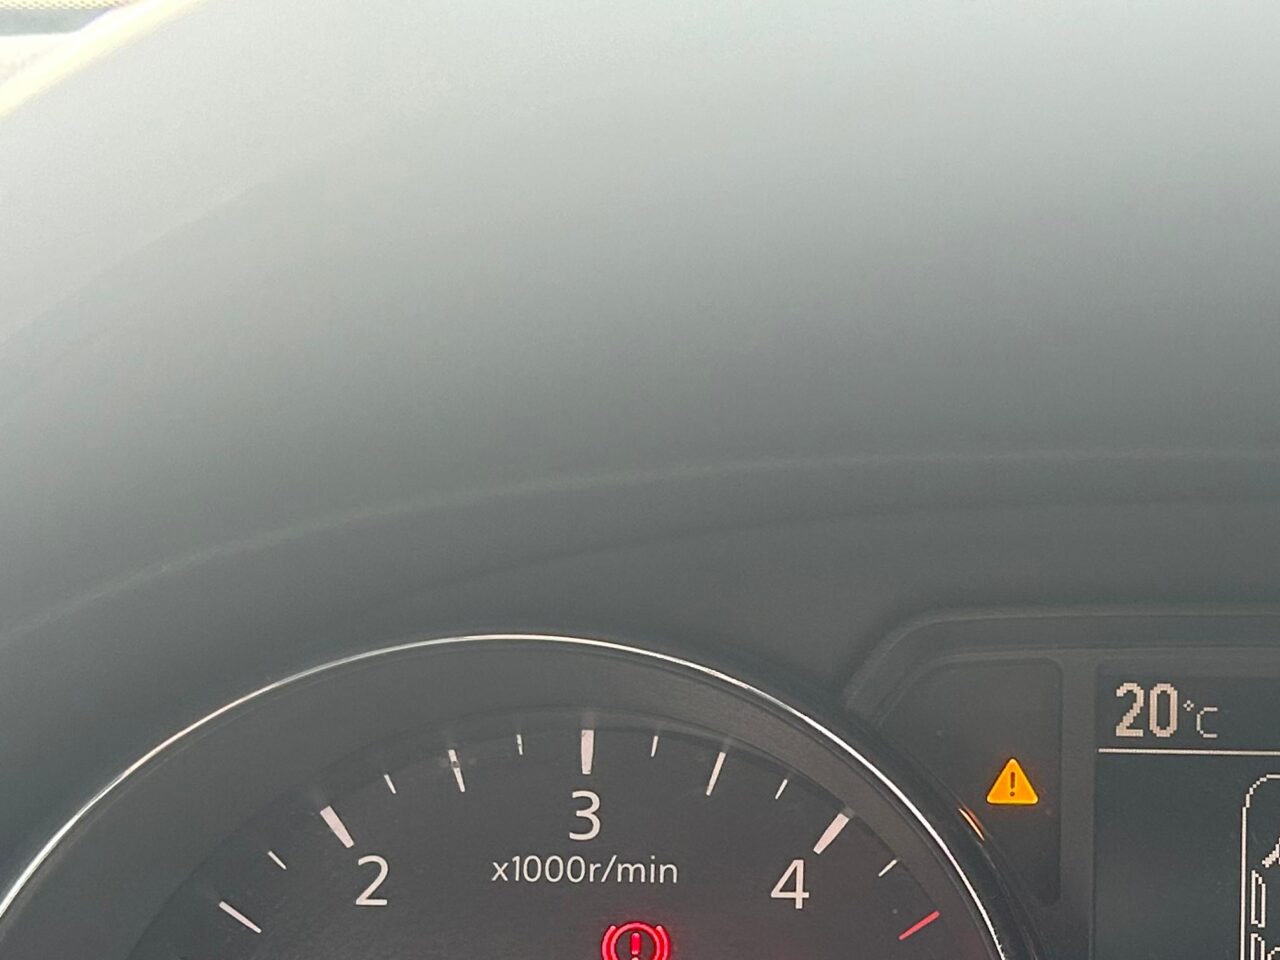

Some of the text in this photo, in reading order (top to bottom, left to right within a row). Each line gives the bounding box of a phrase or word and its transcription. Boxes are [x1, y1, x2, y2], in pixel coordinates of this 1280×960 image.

[569, 790, 601, 841] 3
[355, 855, 389, 906] 2
[491, 854, 678, 884] x1000r/min
[770, 859, 810, 910] 4
